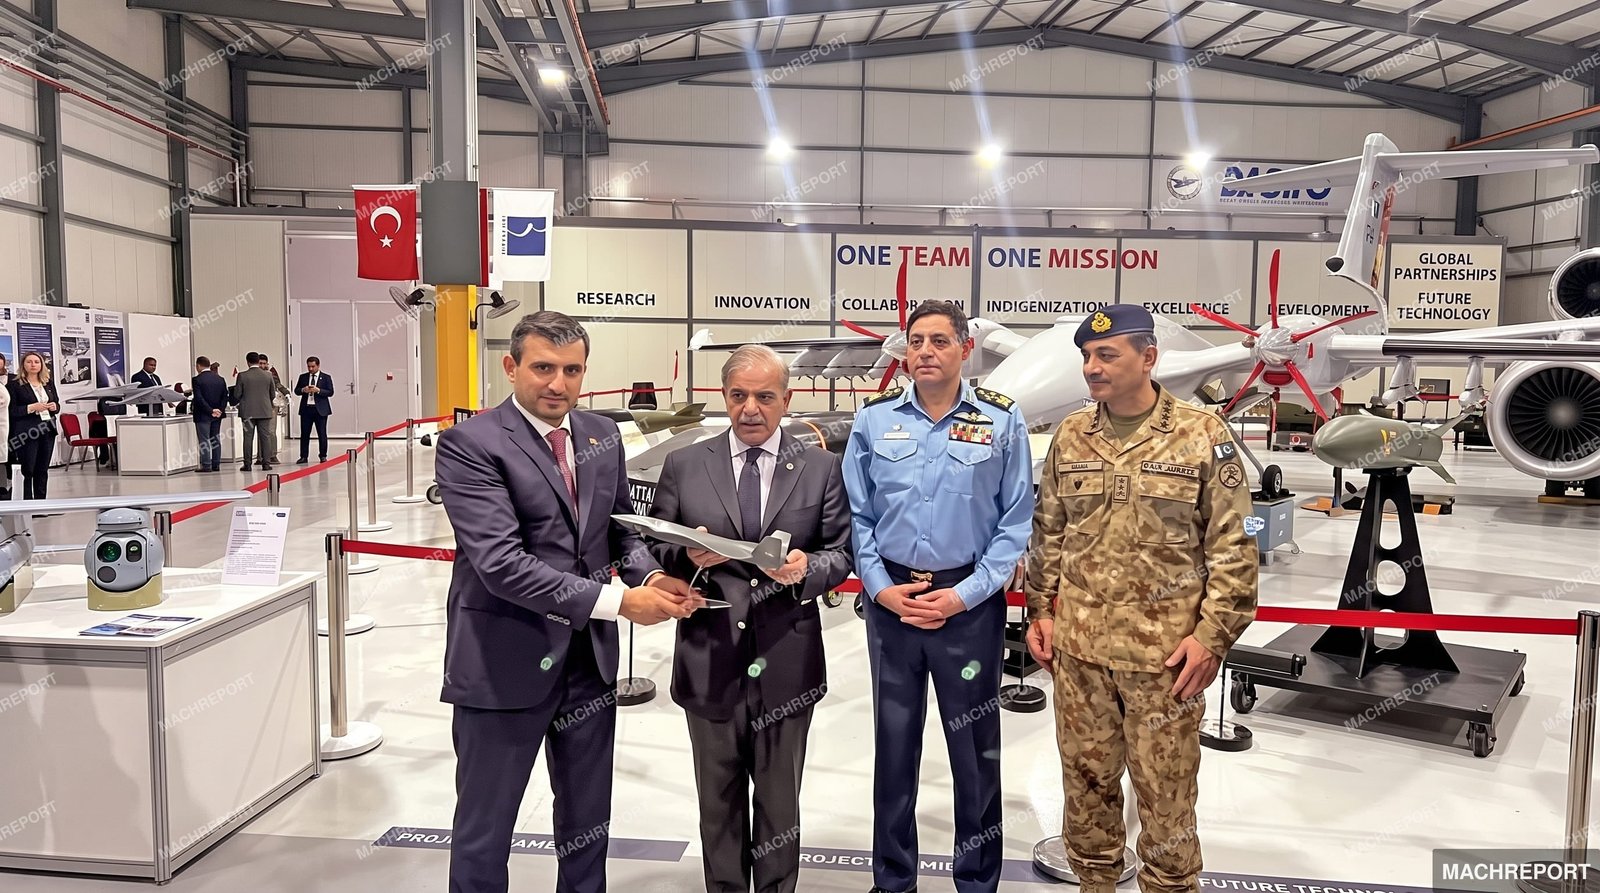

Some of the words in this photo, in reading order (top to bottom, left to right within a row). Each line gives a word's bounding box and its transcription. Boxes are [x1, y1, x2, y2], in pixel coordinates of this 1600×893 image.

[837, 245, 891, 266] ONE
[898, 246, 970, 267] TEAM
[988, 248, 1041, 268] ONE
[1048, 248, 1158, 269] MISSION
[1419, 253, 1473, 265] GLOBAL
[1394, 268, 1497, 281] PARTNERSHIPS
[577, 292, 656, 306] RESEARCH
[714, 295, 810, 310] INNOVATION
[1418, 292, 1472, 305] FUTURE
[1397, 308, 1491, 320] TECHNOLOGY
[628, 483, 656, 503] ATTA
[799, 853, 873, 867] ROJECT
[1198, 877, 1291, 893] FUTURE
